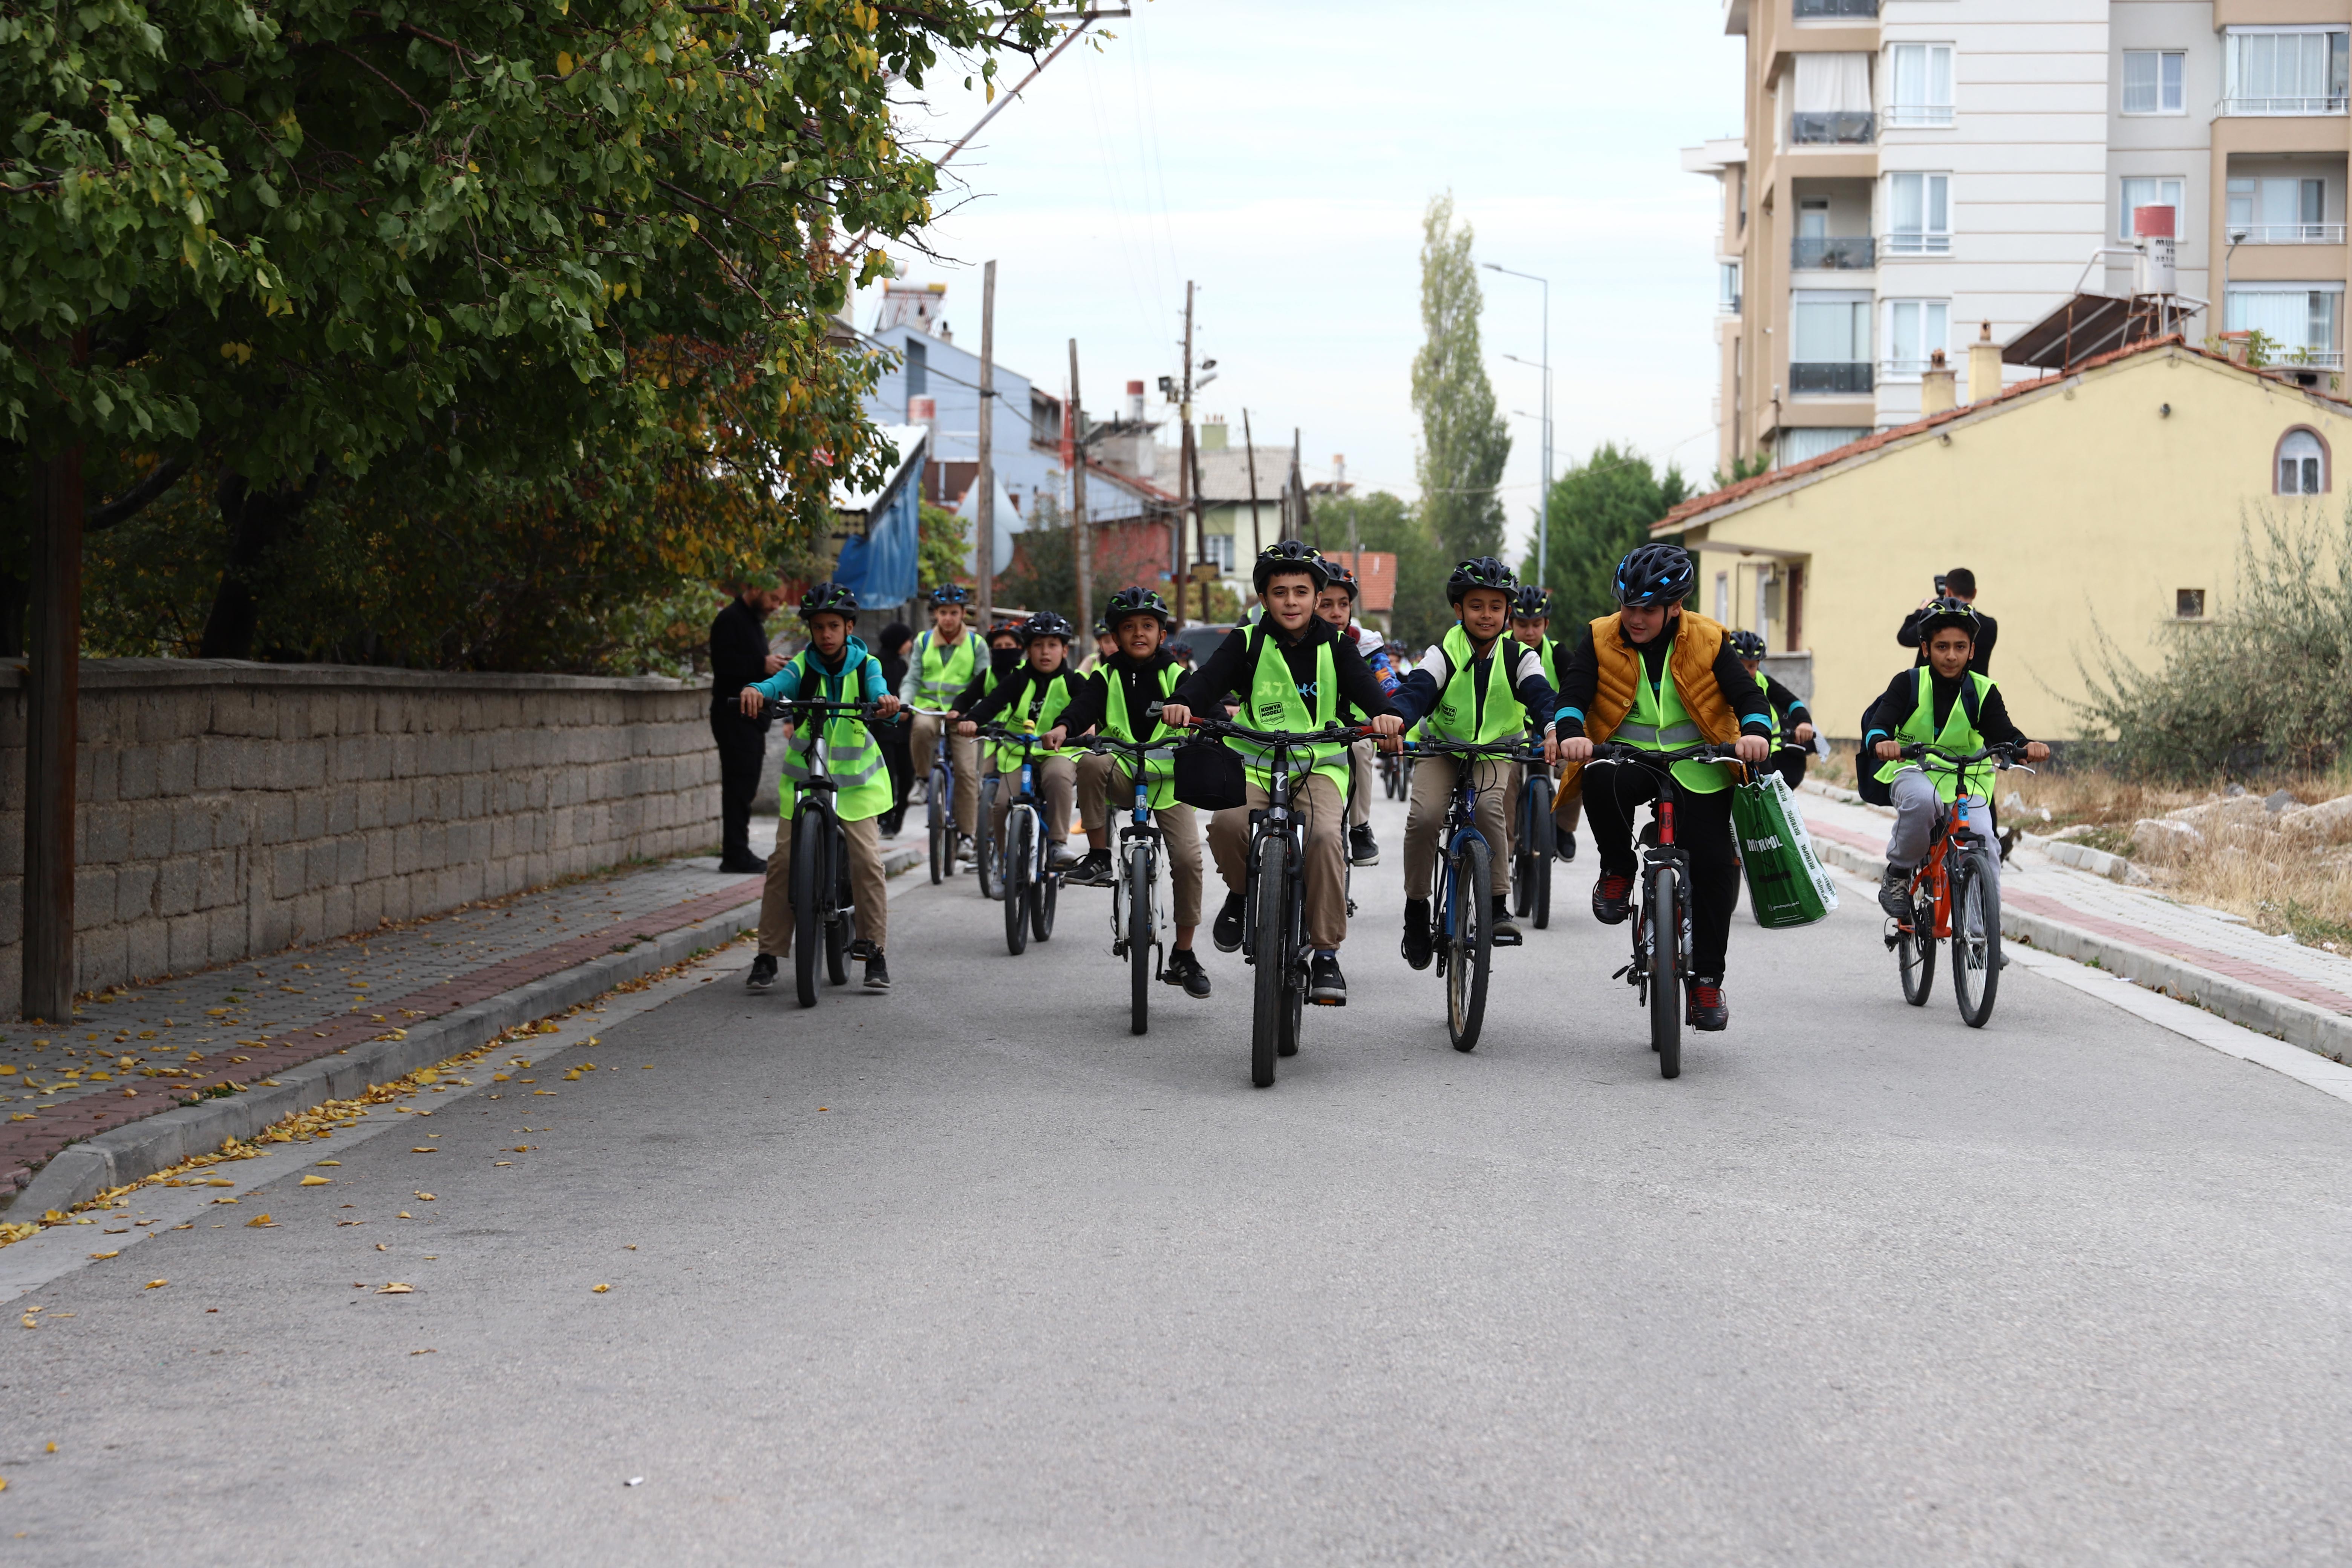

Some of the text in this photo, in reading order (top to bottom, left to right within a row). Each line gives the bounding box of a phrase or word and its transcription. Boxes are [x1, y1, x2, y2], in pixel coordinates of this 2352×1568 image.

[1261, 704, 1281, 712] KONYA
[1774, 777, 1787, 802] METROPOL
[1787, 809, 1801, 836] METROPOL
[1801, 844, 1815, 870] METROPOL
